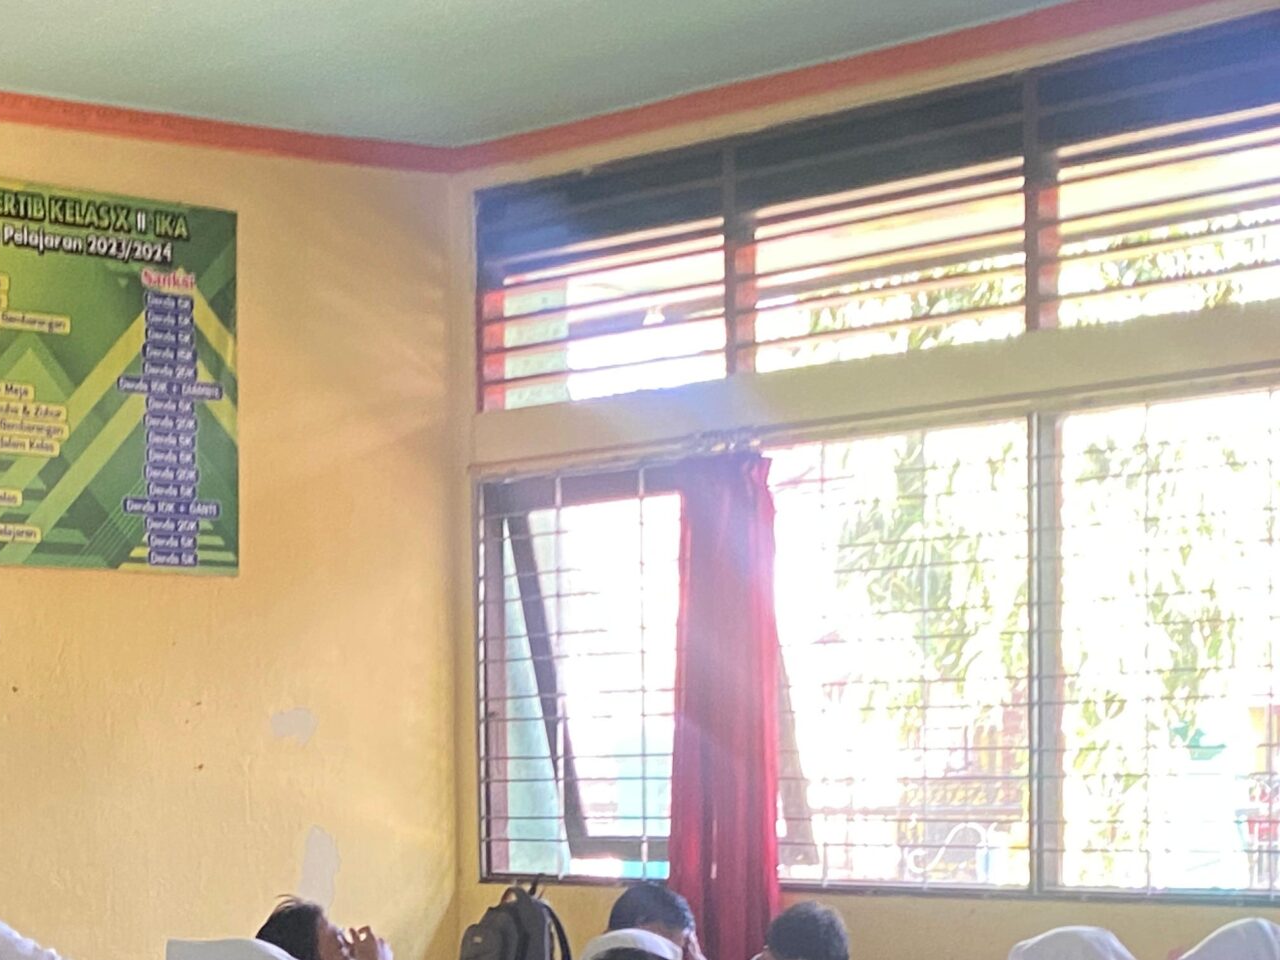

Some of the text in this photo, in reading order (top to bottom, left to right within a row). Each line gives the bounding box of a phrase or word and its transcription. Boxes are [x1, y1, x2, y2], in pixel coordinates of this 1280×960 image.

[48, 196, 111, 230] KELAS
[154, 210, 190, 240] IKA
[3, 223, 83, 256] Pelajaran
[86, 235, 172, 264] 2023/2024
[142, 268, 194, 289] Sanksi
